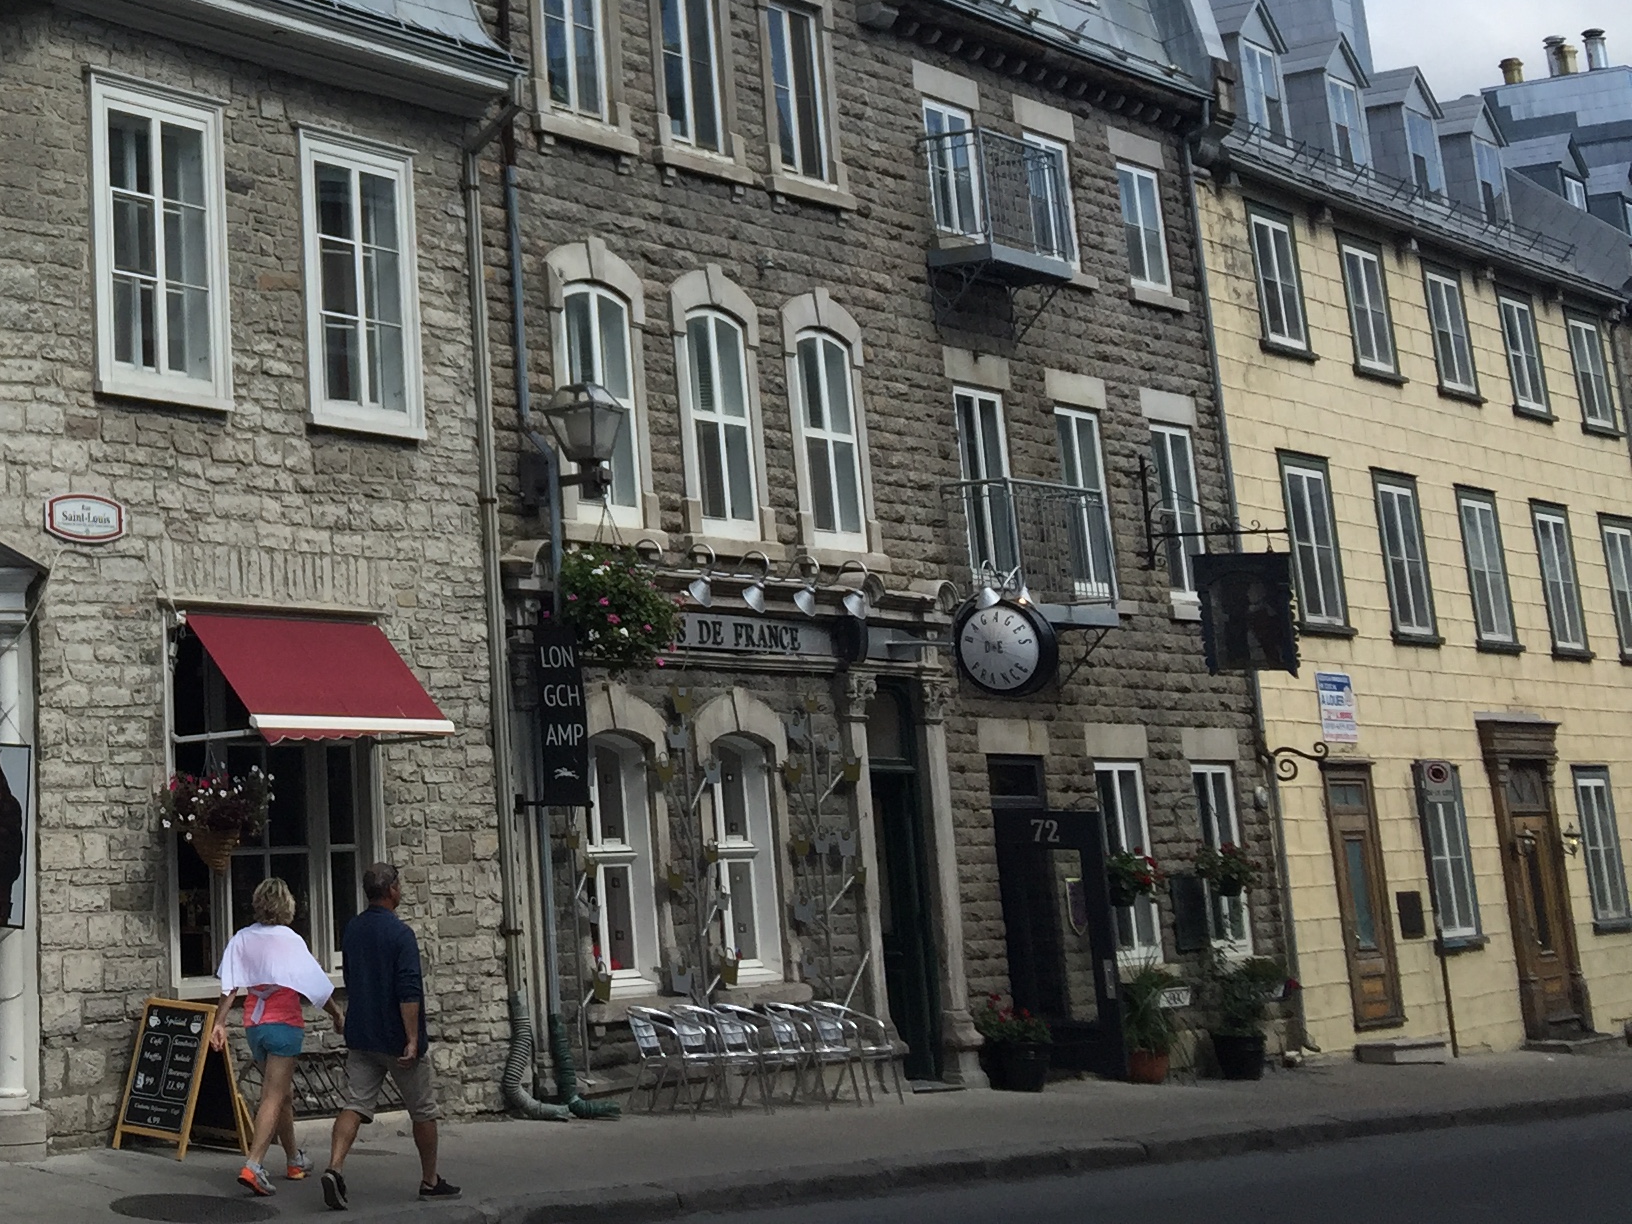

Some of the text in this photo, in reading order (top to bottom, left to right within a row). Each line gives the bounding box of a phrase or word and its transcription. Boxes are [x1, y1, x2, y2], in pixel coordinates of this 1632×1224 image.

[62, 510, 110, 524] Saint-Louis
[697, 619, 724, 646] DE
[732, 622, 801, 651] FRANCE
[965, 611, 1032, 644] BAGAGES
[540, 645, 575, 668] LON
[971, 661, 1028, 685] FRANCE
[543, 684, 580, 707] GCH
[546, 723, 584, 746] AMP
[1030, 819, 1060, 842] 72
